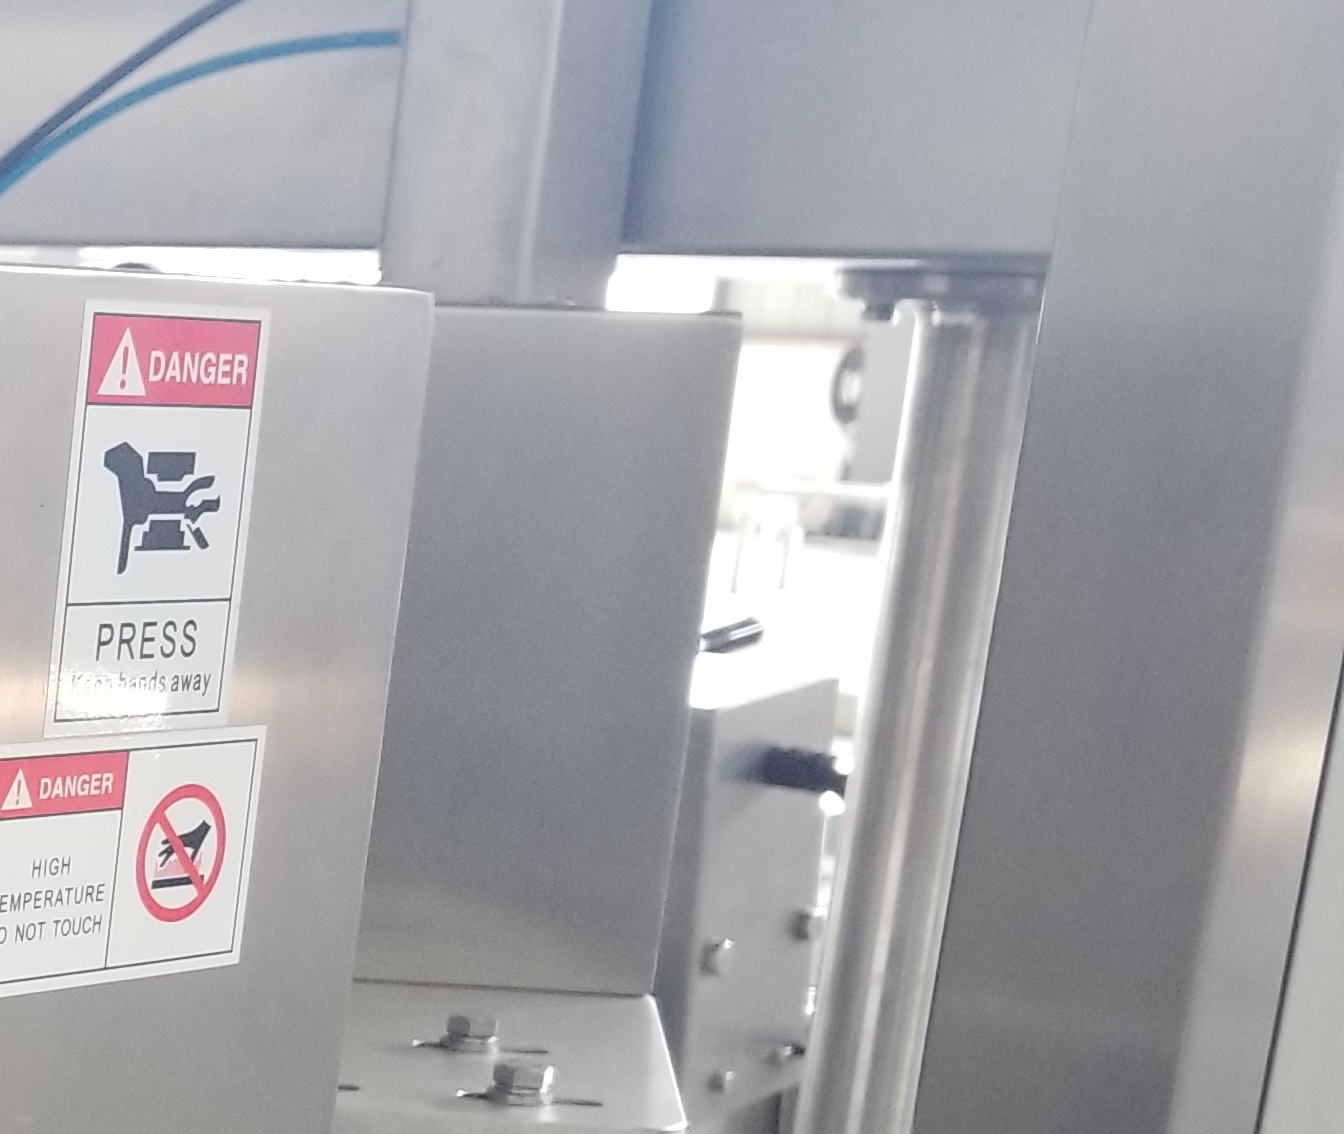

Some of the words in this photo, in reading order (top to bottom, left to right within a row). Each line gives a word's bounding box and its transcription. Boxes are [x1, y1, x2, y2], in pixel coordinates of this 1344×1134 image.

[148, 349, 249, 386] DANGER
[95, 618, 199, 662] PRESS
[118, 670, 167, 694] hands
[170, 672, 212, 697] away
[38, 772, 114, 800] DANGER
[31, 856, 72, 879] HIGH
[14, 921, 47, 943] NOT
[52, 915, 103, 938] TOUCH
